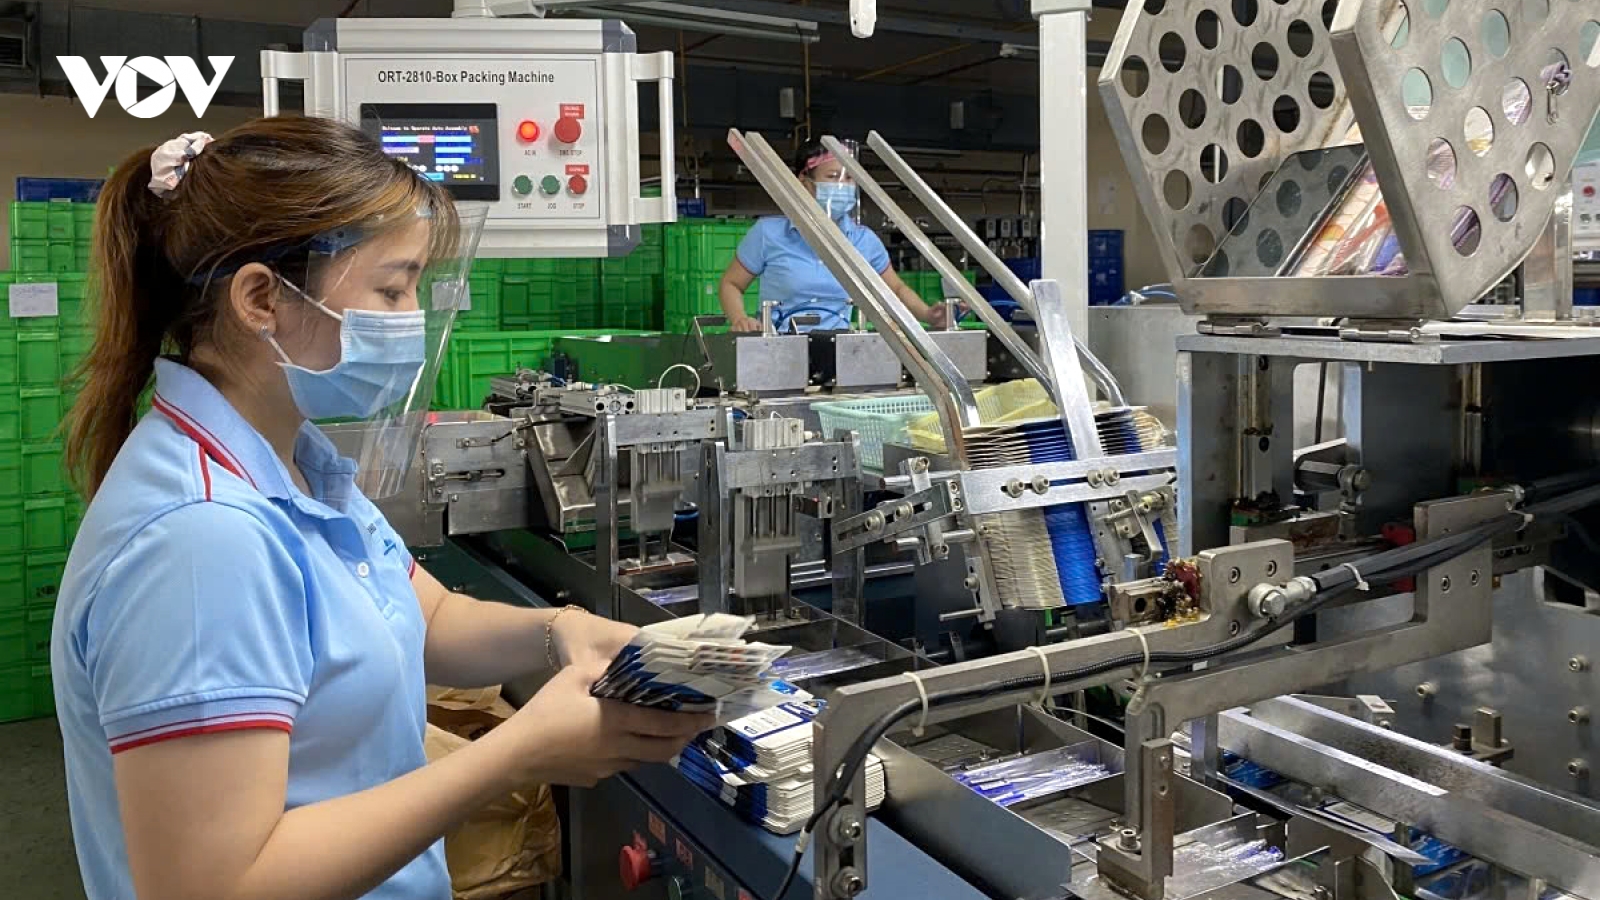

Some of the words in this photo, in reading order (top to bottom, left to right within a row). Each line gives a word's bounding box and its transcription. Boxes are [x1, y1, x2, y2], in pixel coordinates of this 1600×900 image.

[378, 70, 458, 83] ORT-2810-Box
[460, 70, 505, 86] Packing
[507, 70, 555, 83] Machine
[517, 202, 533, 210] START
[572, 202, 585, 210] STOP
